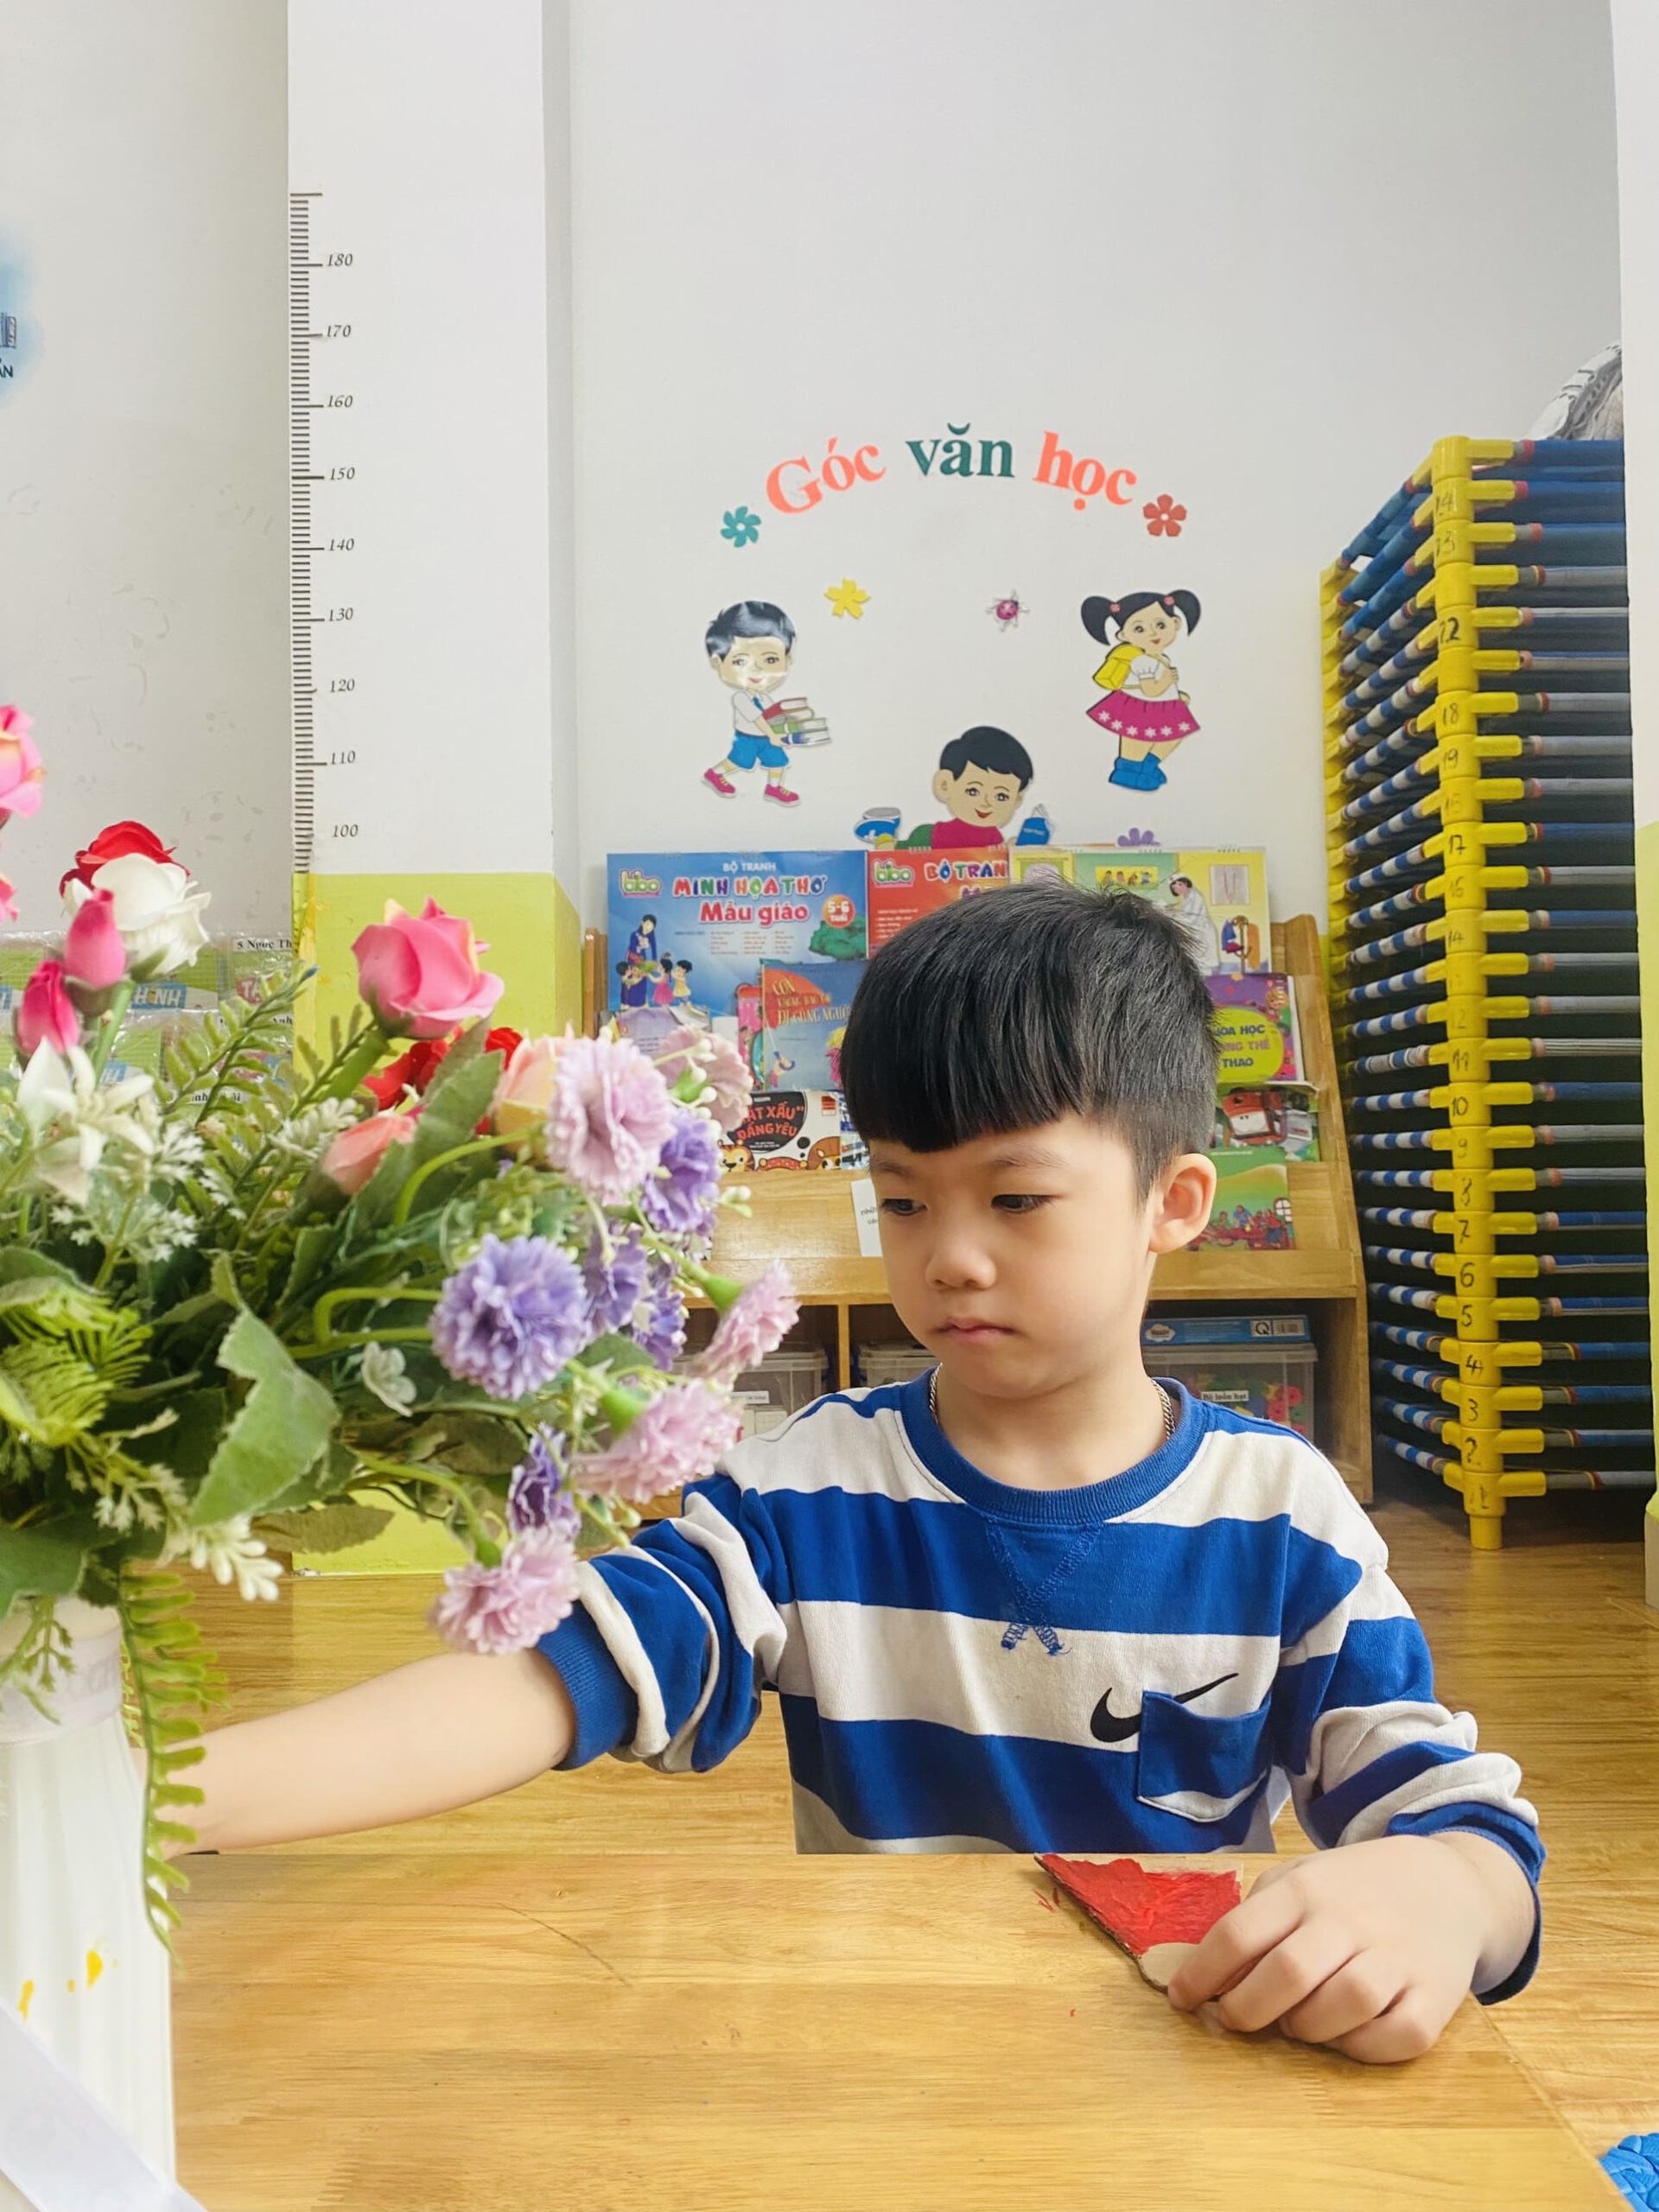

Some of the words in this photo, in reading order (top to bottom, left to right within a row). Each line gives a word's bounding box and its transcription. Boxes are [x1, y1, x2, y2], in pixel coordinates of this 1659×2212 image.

[327, 253, 353, 267] 180
[326, 324, 352, 338] 170
[327, 395, 353, 408] 160
[328, 467, 355, 480] 150
[766, 437, 887, 514] Góc
[905, 423, 1015, 478] văn
[1032, 429, 1138, 511] học
[328, 538, 355, 551] 140
[328, 608, 353, 621] 130
[329, 679, 355, 692] 120
[1443, 702, 1459, 726] 18
[330, 751, 356, 765] 110
[1443, 748, 1459, 770] 19
[332, 824, 359, 837] 100
[1449, 834, 1466, 855] 17
[723, 861, 738, 874] BỘ
[741, 862, 777, 872] TRANH
[674, 877, 728, 896] MINH
[735, 876, 779, 899] HỌA
[780, 875, 827, 896] THƠ
[700, 900, 752, 923] Mẫu
[758, 902, 809, 926] giáo
[1452, 1096, 1468, 1117] 10
[1459, 1219, 1471, 1243] 7
[1460, 1262, 1475, 1287] 6
[1461, 1304, 1472, 1327] 5
[1465, 1354, 1483, 1378] 4
[1468, 1398, 1478, 1421] 3
